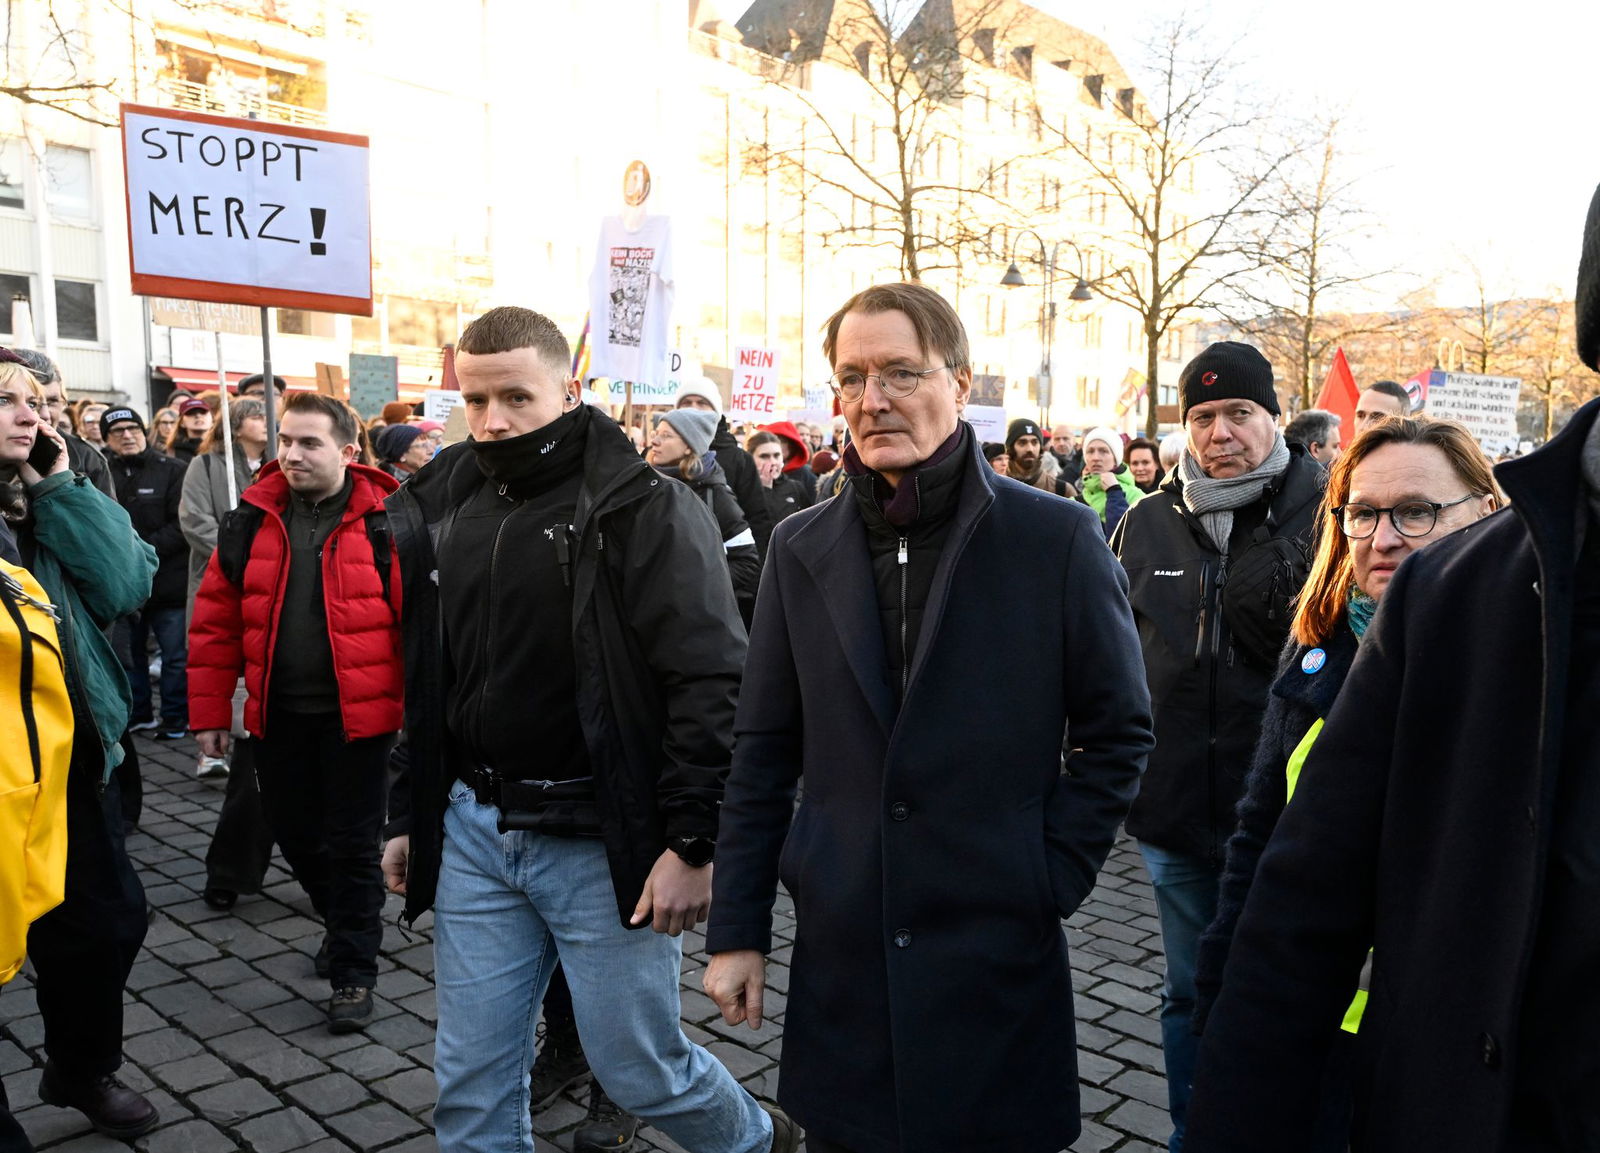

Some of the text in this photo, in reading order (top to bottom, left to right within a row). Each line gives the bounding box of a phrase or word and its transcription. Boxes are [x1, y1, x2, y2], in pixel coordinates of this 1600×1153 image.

[141, 127, 318, 182] STOPPT
[629, 249, 653, 260] BOCK
[740, 350, 773, 368] NEIN
[743, 375, 764, 390] ZU
[732, 394, 775, 413] HETZE
